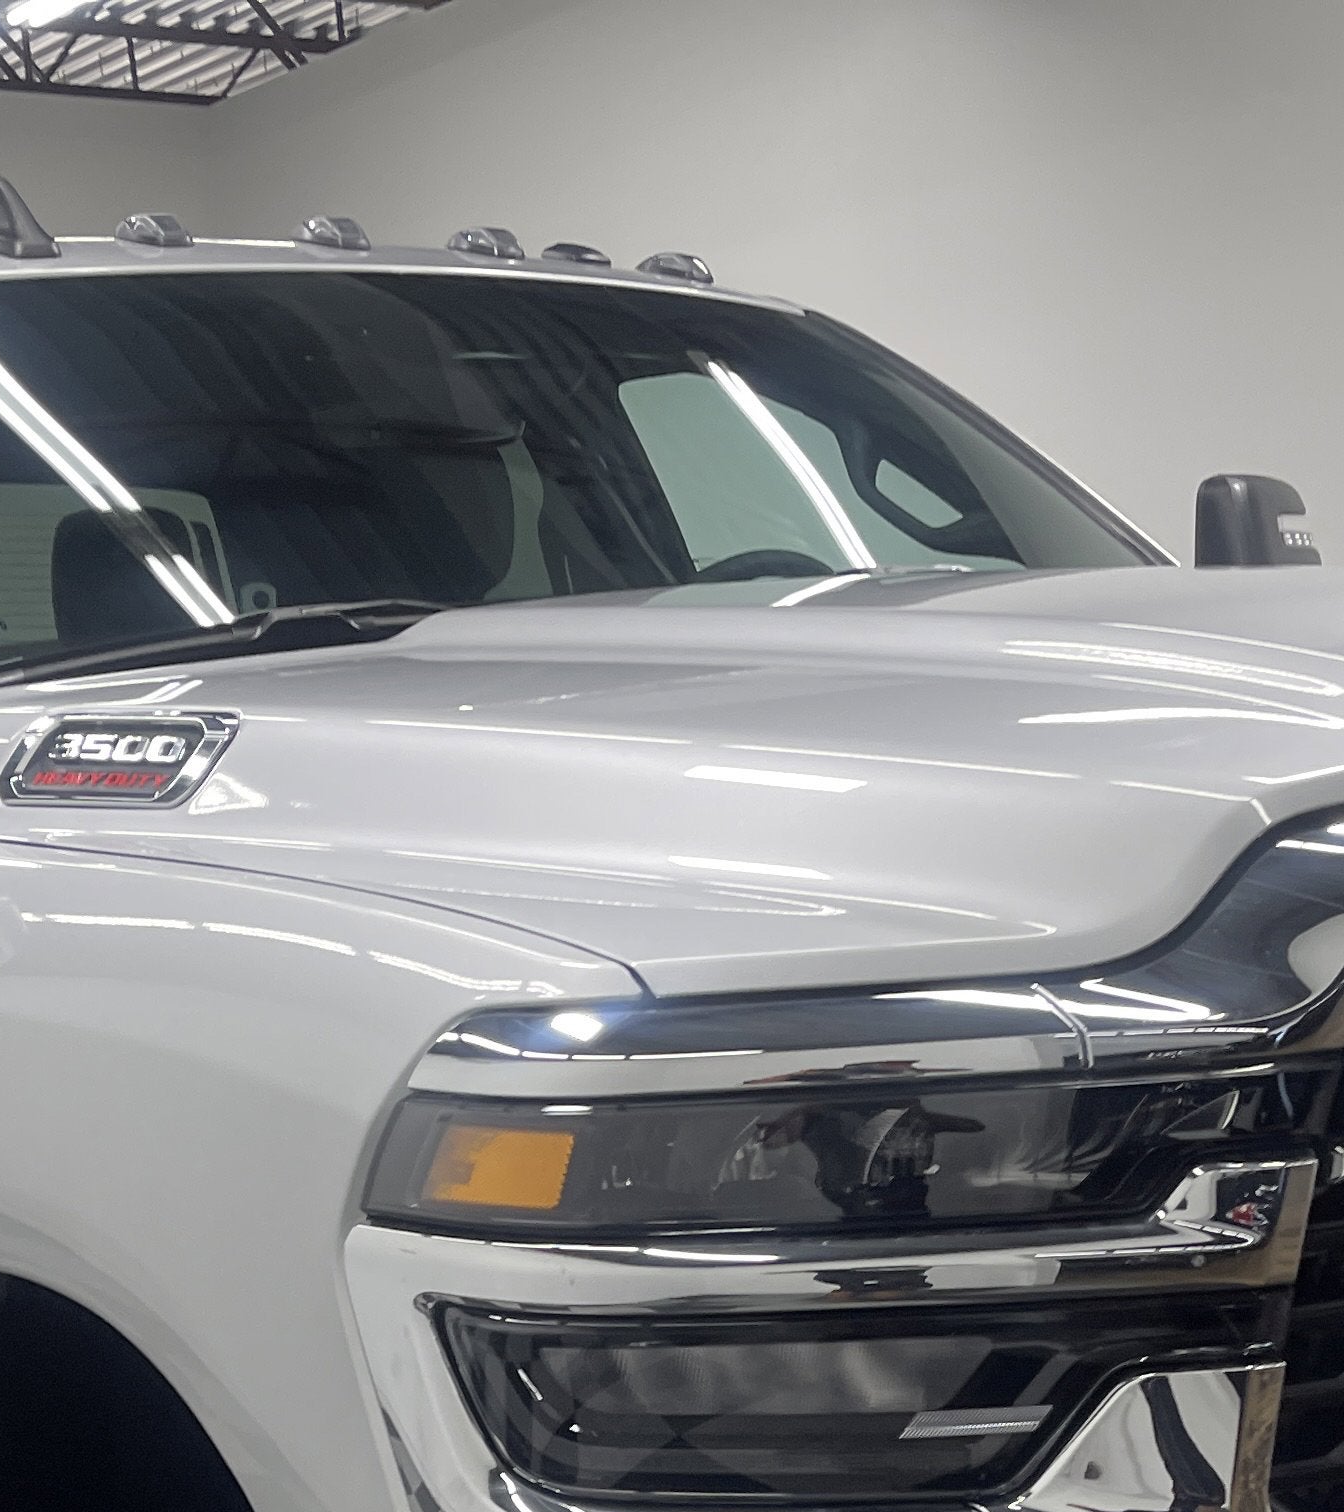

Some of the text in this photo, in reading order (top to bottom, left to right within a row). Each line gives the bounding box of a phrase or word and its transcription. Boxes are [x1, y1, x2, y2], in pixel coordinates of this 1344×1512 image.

[48, 733, 186, 763] 3500
[33, 771, 170, 788] HEAVY DUTY
